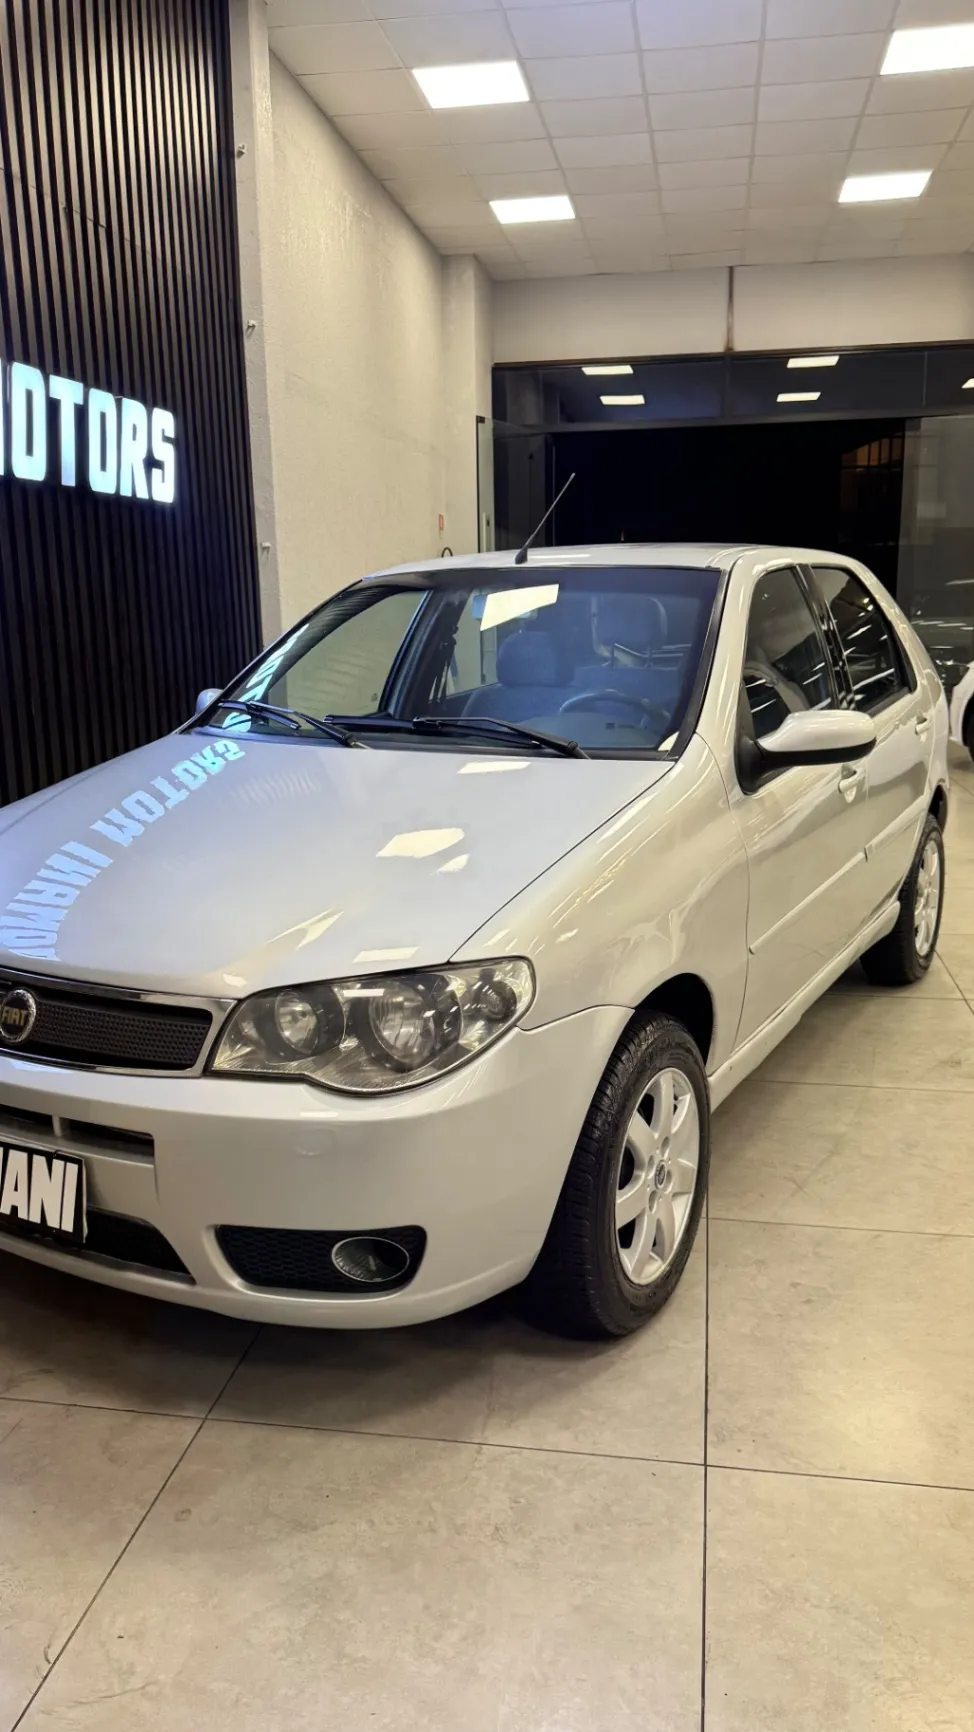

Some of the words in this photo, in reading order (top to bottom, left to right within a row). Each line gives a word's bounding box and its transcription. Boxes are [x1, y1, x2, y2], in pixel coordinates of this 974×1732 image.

[0, 358, 175, 504] OTORS
[1, 1005, 29, 1026] FIAT
[0, 1146, 79, 1233] ANI
